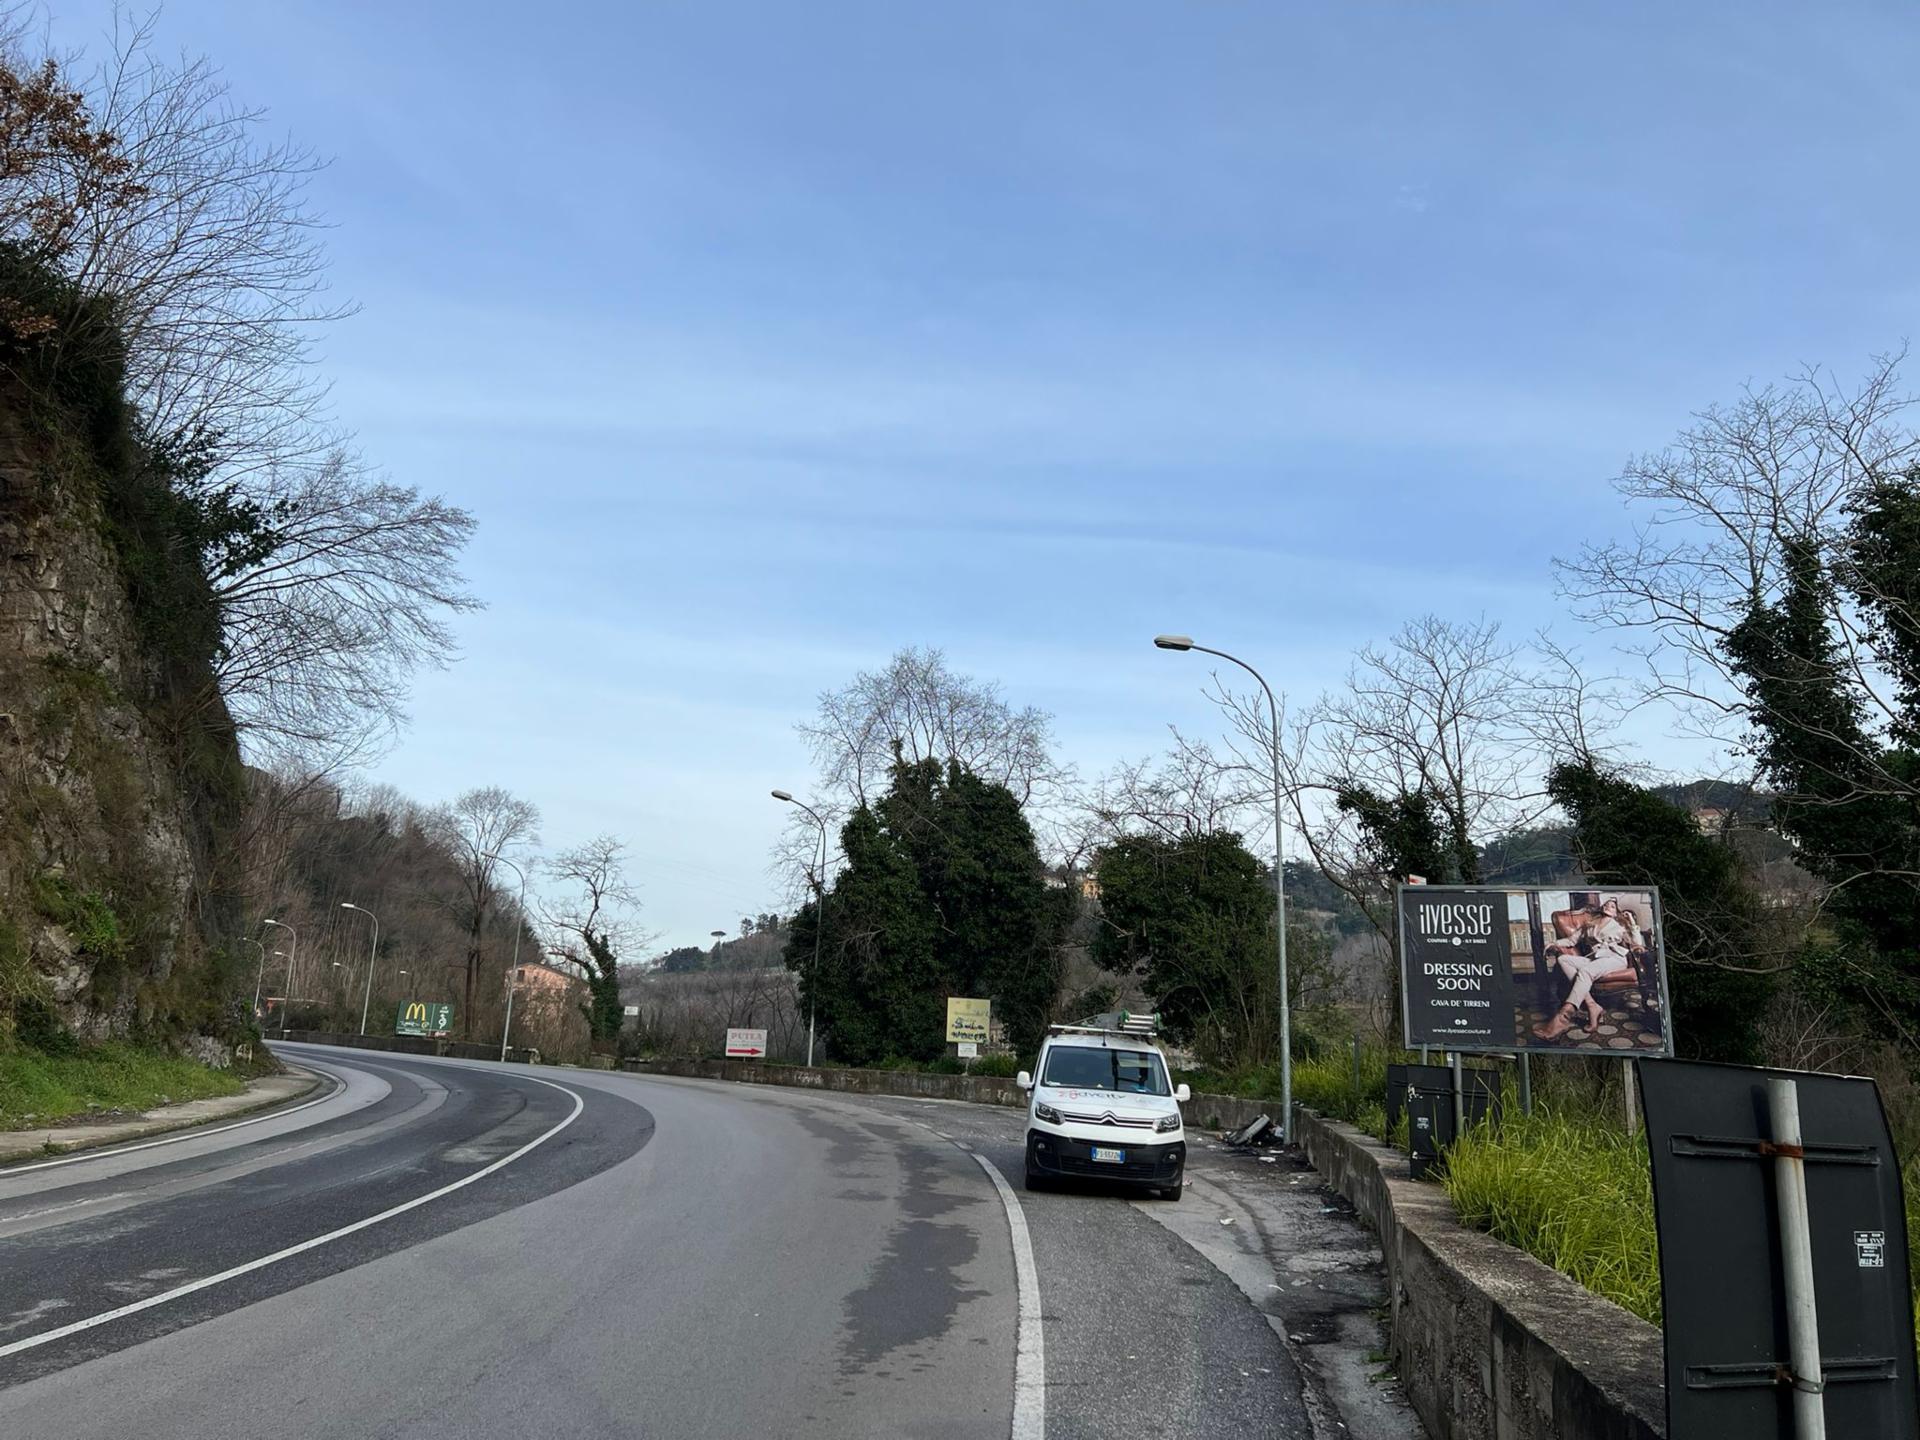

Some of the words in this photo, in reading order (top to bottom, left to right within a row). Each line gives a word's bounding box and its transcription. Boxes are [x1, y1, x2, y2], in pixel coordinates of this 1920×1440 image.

[1424, 963, 1493, 976] DRESSING
[1437, 978, 1481, 990] SOON
[1431, 999, 1449, 1007] CAVA
[1451, 999, 1461, 1007] DE'
[1463, 1000, 1490, 1008] TIRRENI
